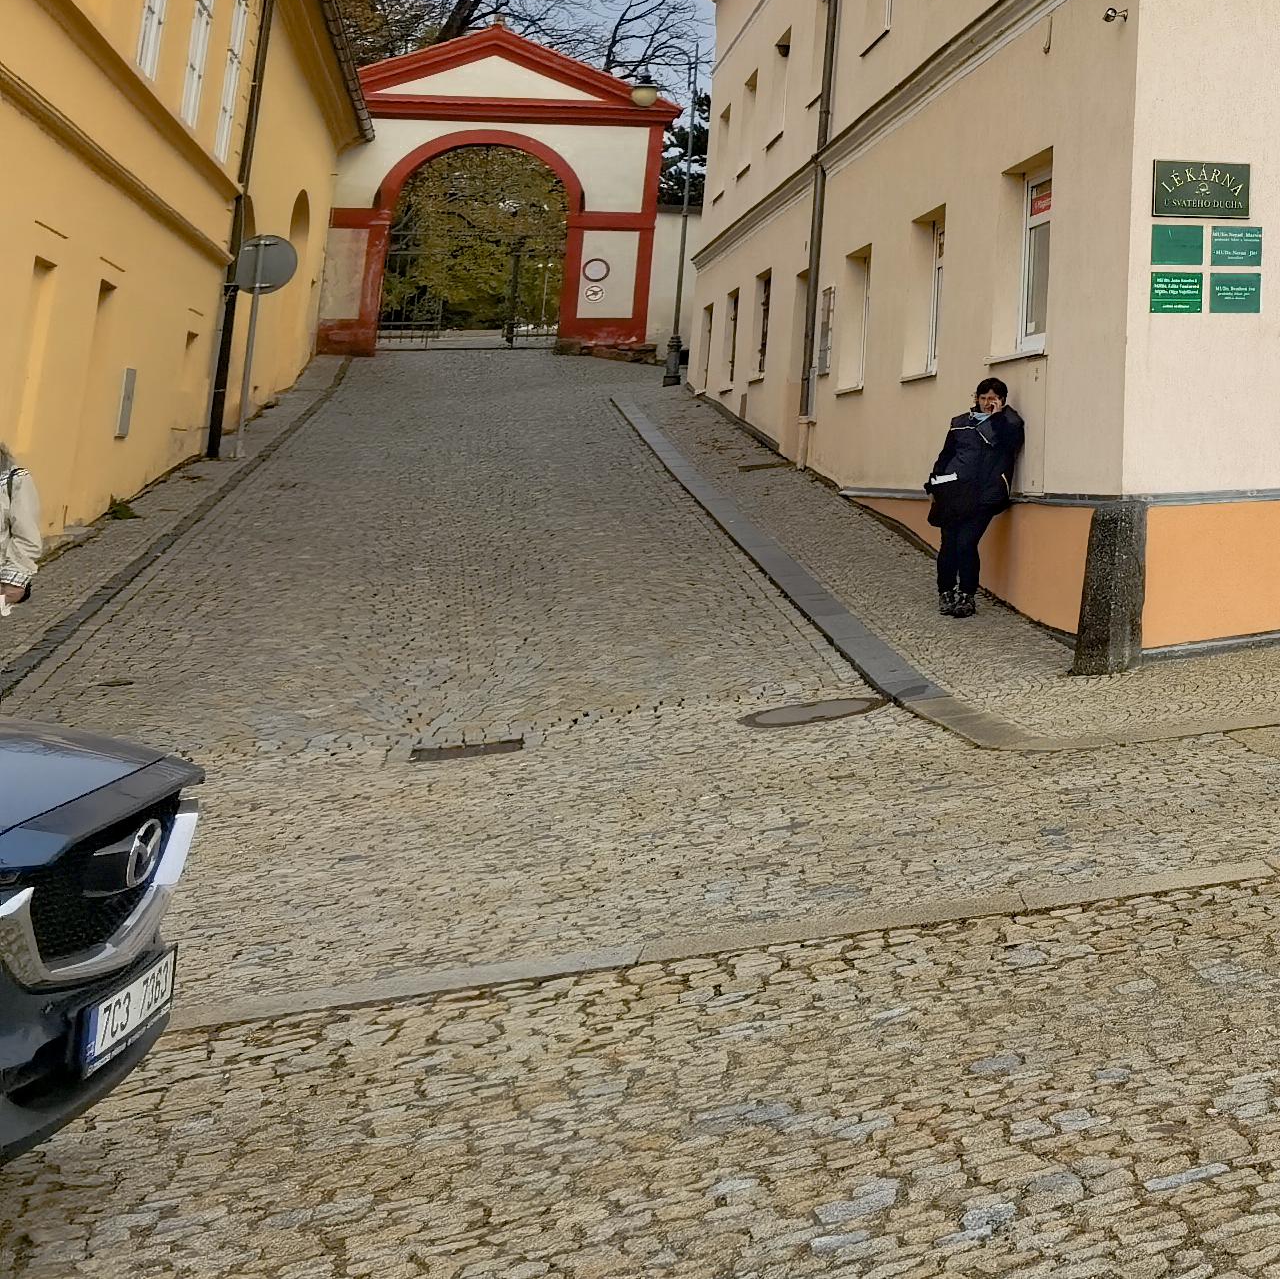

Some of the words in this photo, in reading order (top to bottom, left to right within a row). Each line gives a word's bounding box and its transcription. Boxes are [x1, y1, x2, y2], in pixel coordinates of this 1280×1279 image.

[1161, 163, 1244, 196] LÉKÁRNA
[1212, 200, 1243, 209] DUCHA
[100, 992, 131, 1047] 7C3
